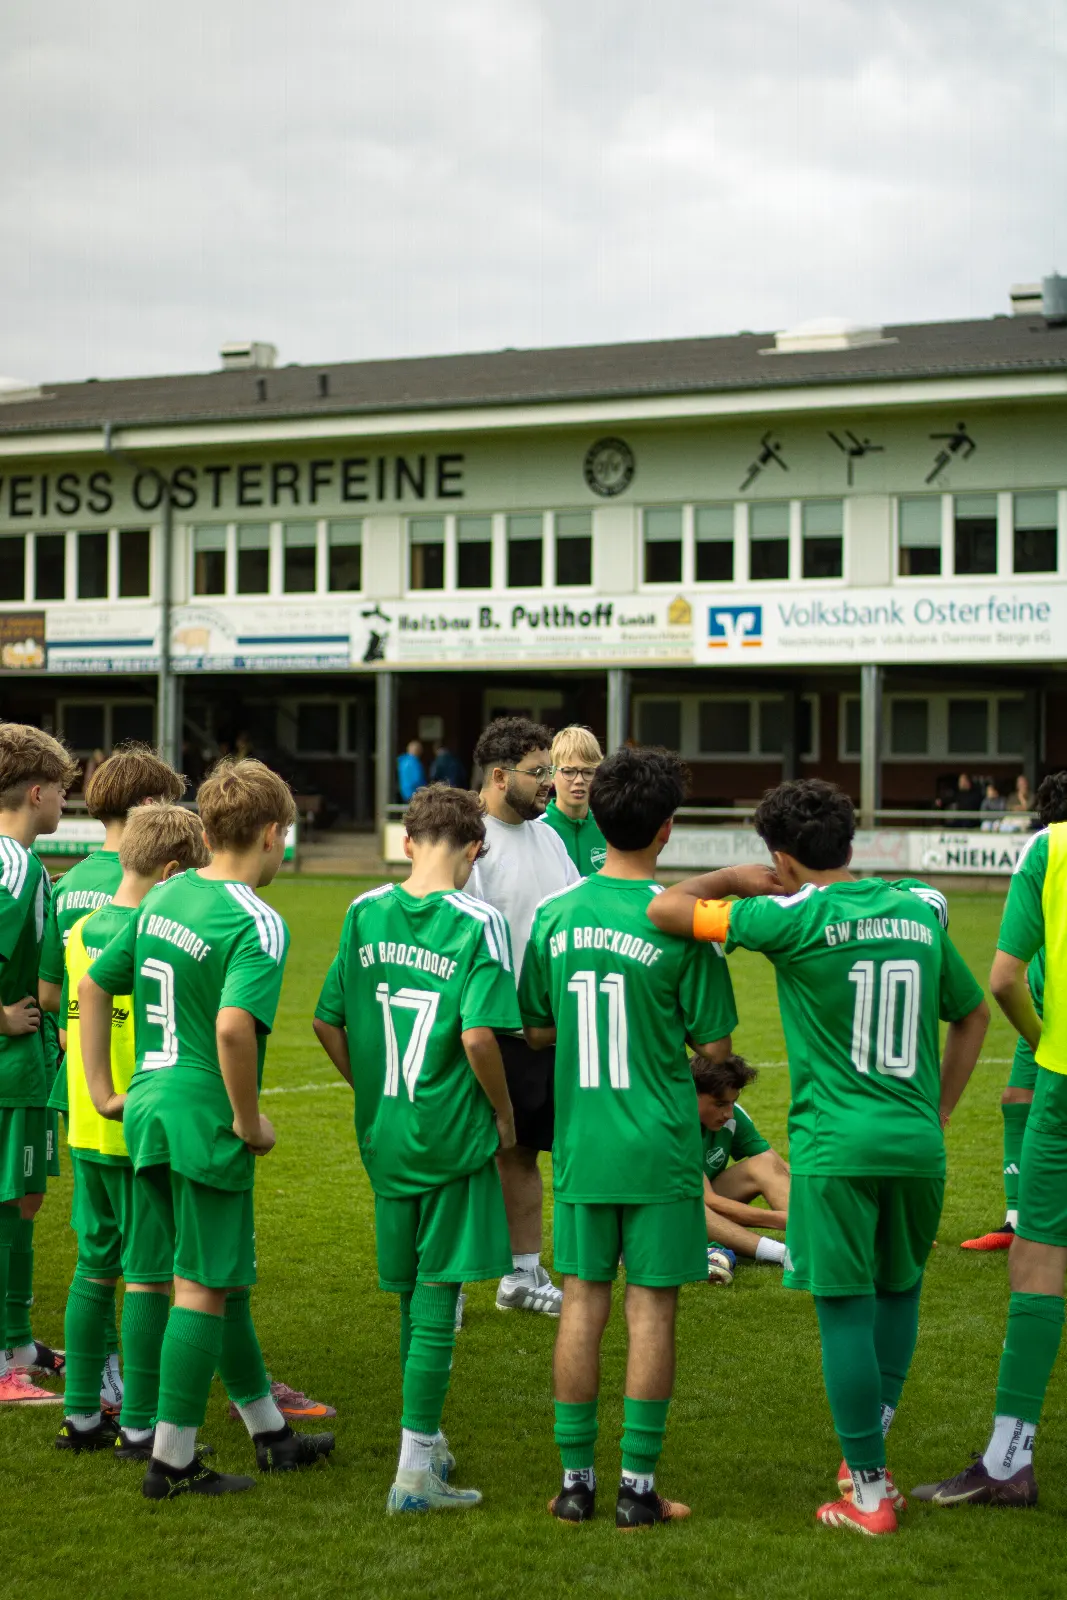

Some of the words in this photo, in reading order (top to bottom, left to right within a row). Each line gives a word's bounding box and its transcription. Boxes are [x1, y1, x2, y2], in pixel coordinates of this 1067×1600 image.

[0, 471, 113, 517] EISS
[133, 455, 464, 511] OSTERFEINE
[511, 602, 613, 628] Putthoff
[778, 600, 904, 627] Volksbank
[914, 596, 1051, 624] Osterfeine
[946, 847, 1020, 868] NIEHA
[146, 914, 212, 962] BROCKDORF
[550, 931, 567, 957] GW
[573, 927, 662, 967] BROCKDORF
[824, 921, 850, 946] GW
[857, 918, 933, 946] BROCKDORF
[358, 944, 375, 968] GW
[378, 941, 457, 980] BROCKDORF
[141, 957, 178, 1070] 3
[567, 970, 629, 1089] 11
[848, 959, 919, 1078] 10
[376, 982, 441, 1103] 17
